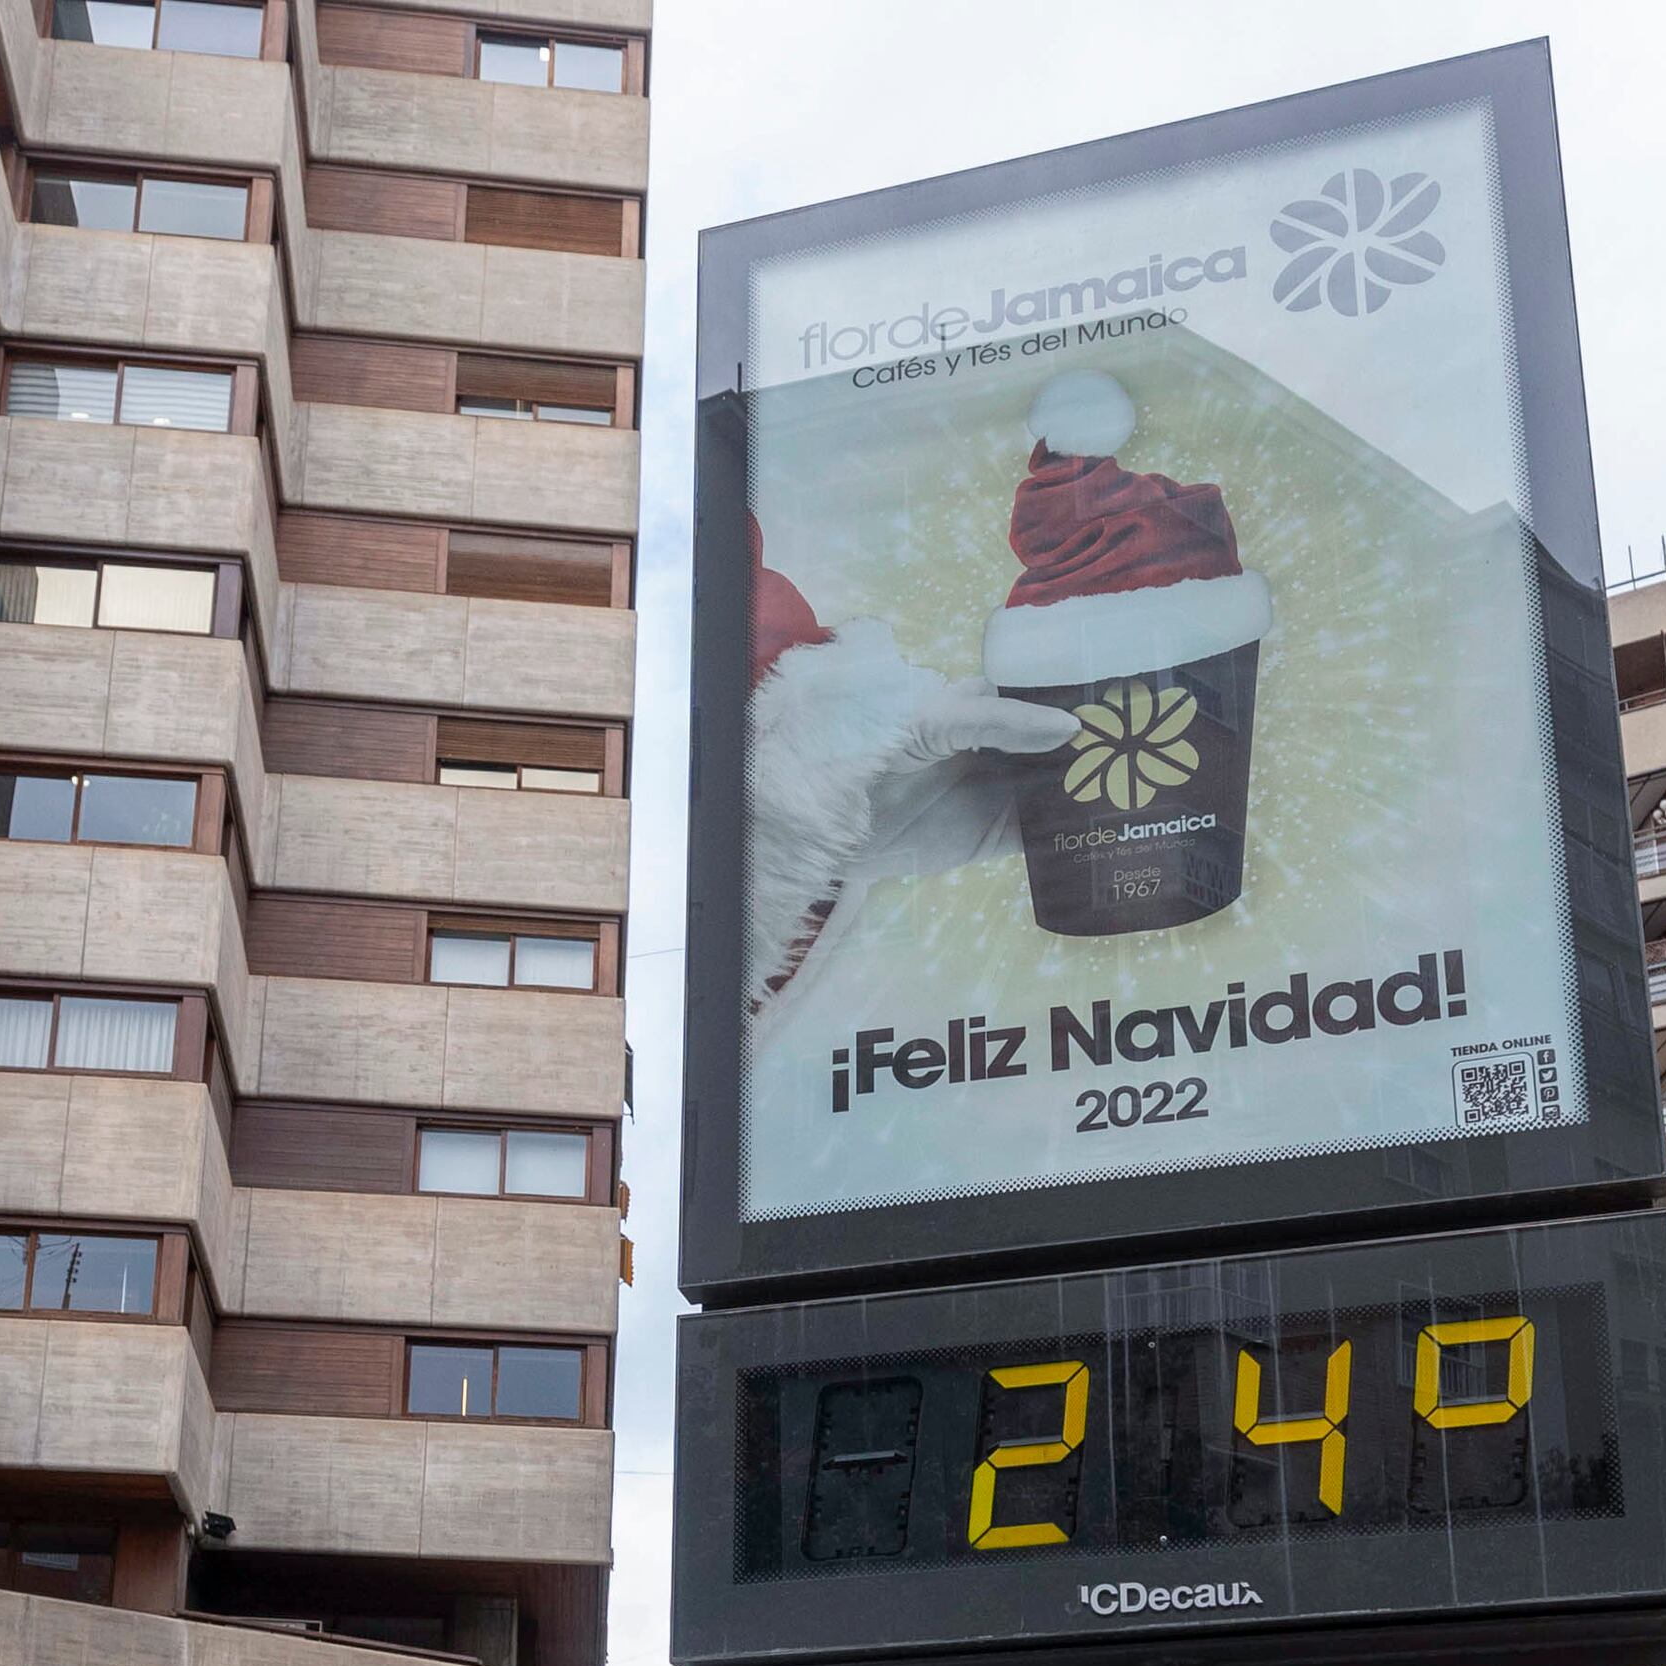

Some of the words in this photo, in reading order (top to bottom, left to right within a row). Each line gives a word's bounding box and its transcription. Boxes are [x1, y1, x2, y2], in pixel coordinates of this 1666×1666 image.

[853, 353, 937, 389] Cafés
[945, 354, 962, 376] y
[967, 341, 1012, 367] Tés
[1021, 329, 1067, 357] del
[1077, 306, 1188, 345] Mundo
[1112, 879, 1161, 900] 1967
[1113, 866, 1161, 882] Desde
[830, 1014, 1028, 1114] ¡Feliz
[1049, 949, 1468, 1074] Navidad!
[1450, 1042, 1499, 1057] TIENDA
[1501, 1034, 1552, 1050] ONLINE
[1074, 1077, 1209, 1135] 2022
